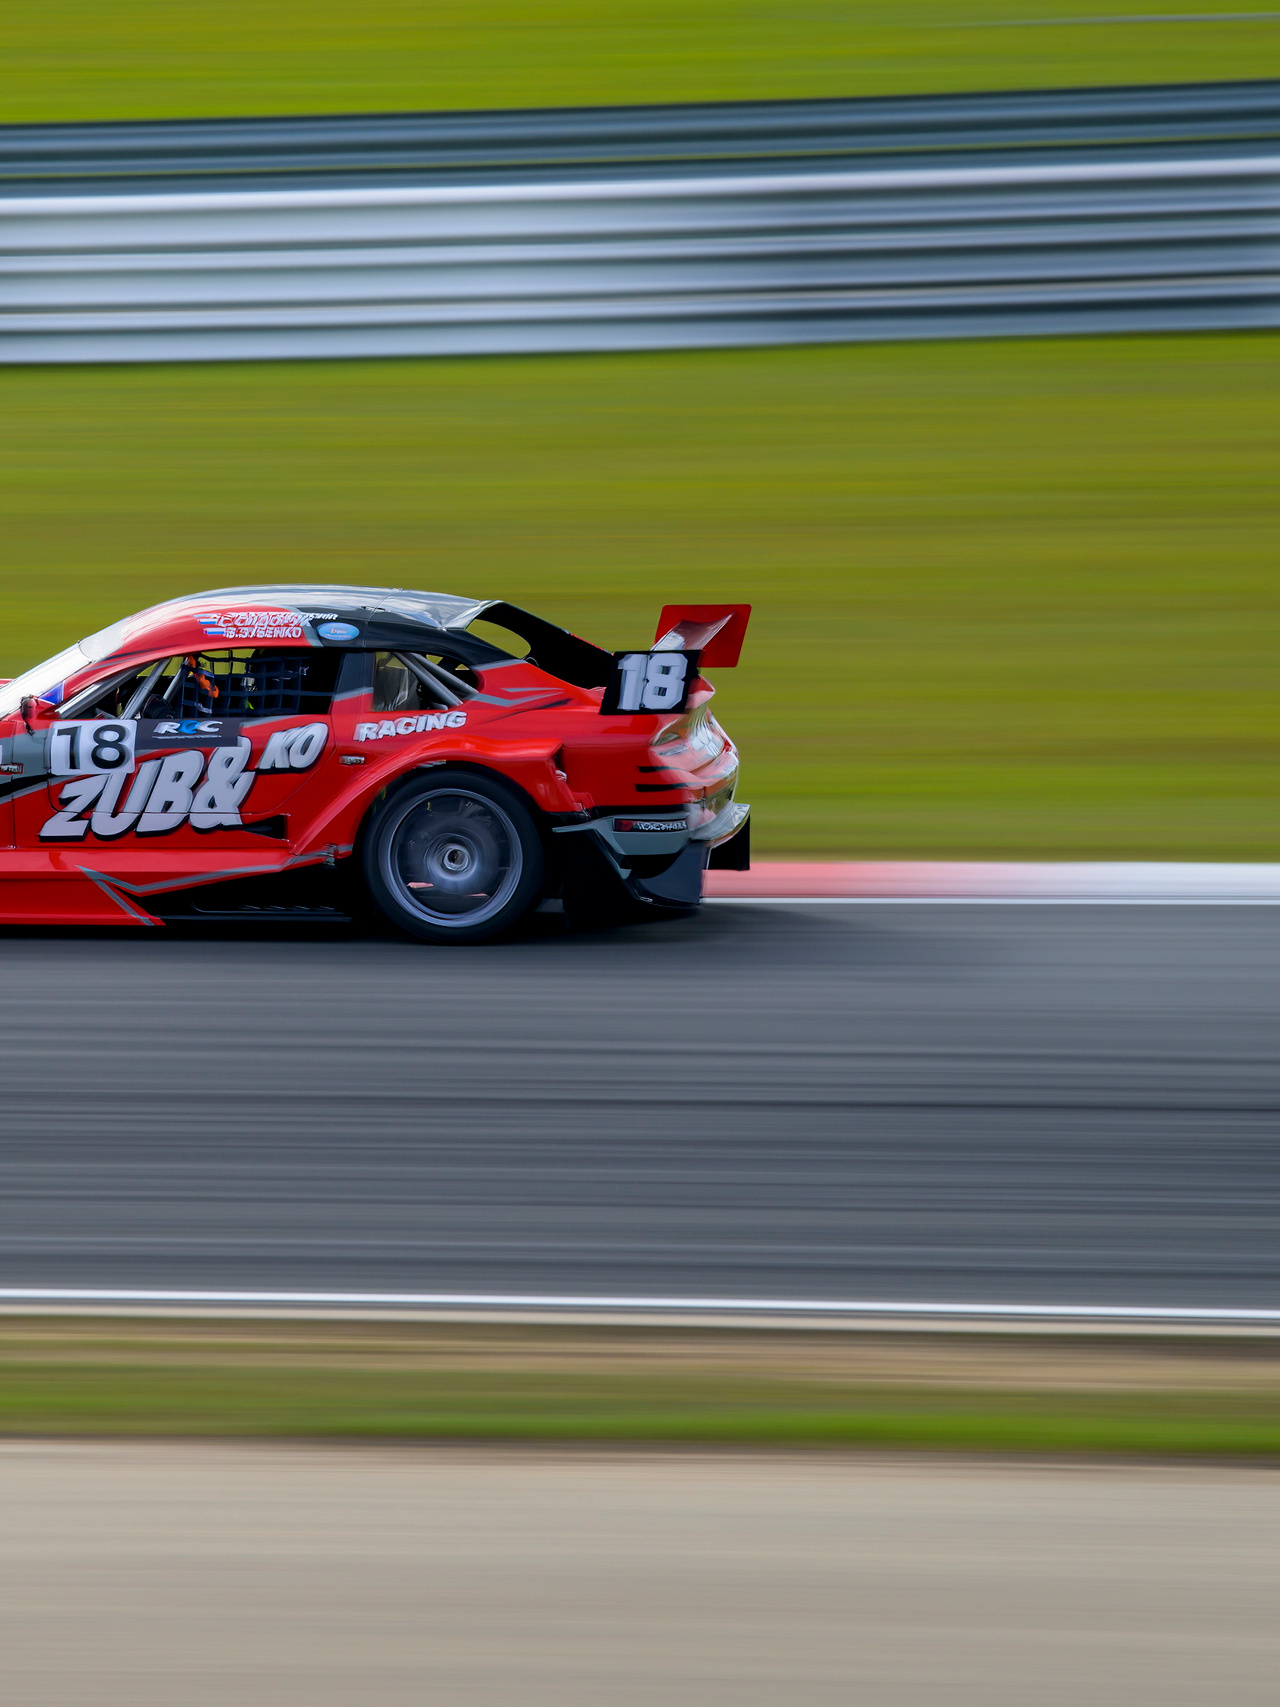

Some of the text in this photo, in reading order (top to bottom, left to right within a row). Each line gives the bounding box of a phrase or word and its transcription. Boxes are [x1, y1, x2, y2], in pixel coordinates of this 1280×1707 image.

[618, 653, 688, 711] 18
[56, 724, 127, 770] 18
[256, 722, 329, 773] KO
[353, 711, 467, 741] RACING
